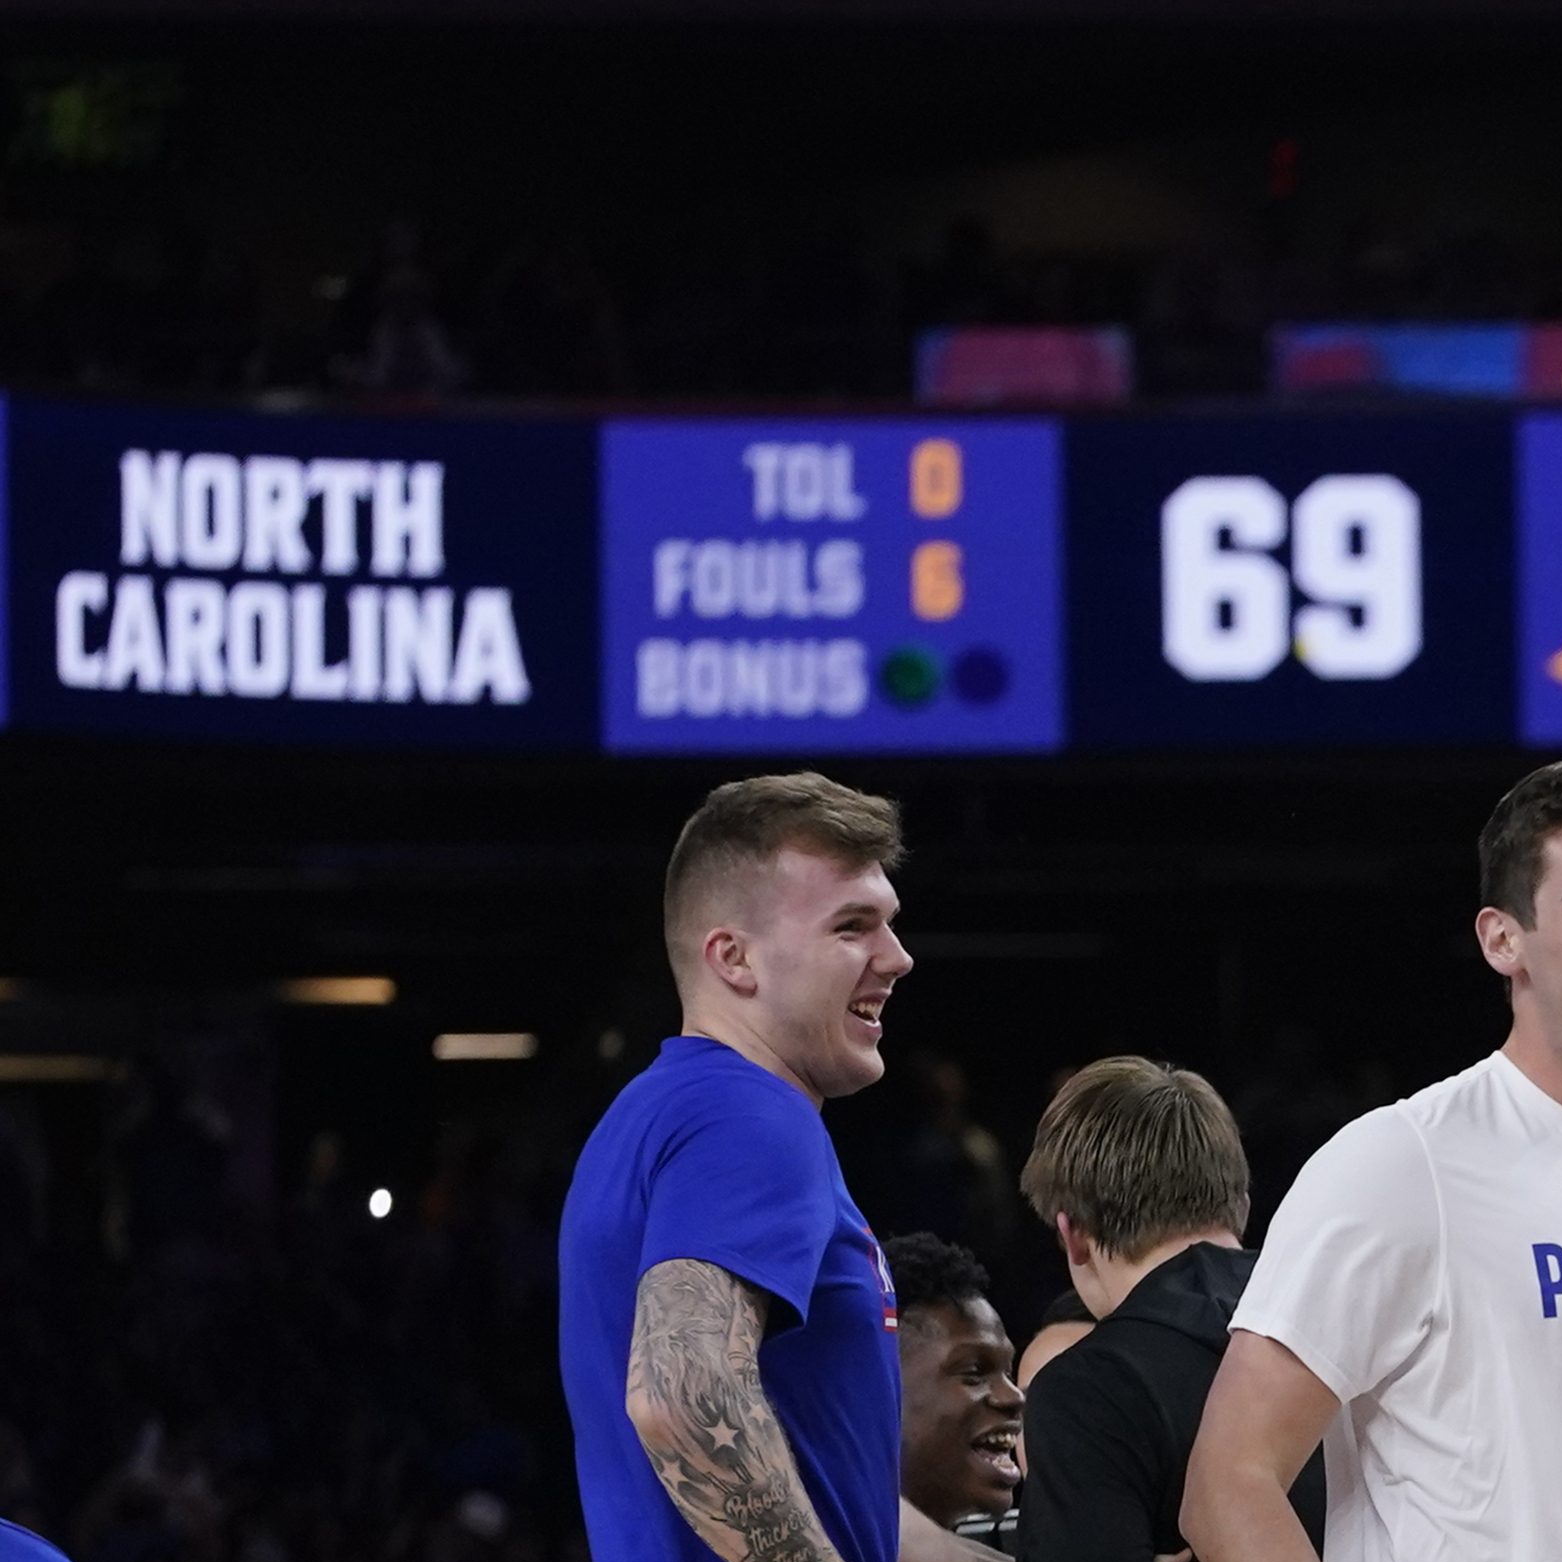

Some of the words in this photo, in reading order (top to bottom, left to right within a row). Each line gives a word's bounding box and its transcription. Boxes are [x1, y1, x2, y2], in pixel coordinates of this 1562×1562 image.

[120, 448, 445, 578] NORTH
[744, 443, 865, 522] TOL
[910, 438, 963, 518] 0
[652, 539, 865, 619] FOULS
[910, 540, 965, 620] 6
[1161, 474, 1423, 682] 69
[55, 571, 532, 706] CAROLINA
[636, 637, 868, 719] BONUS
